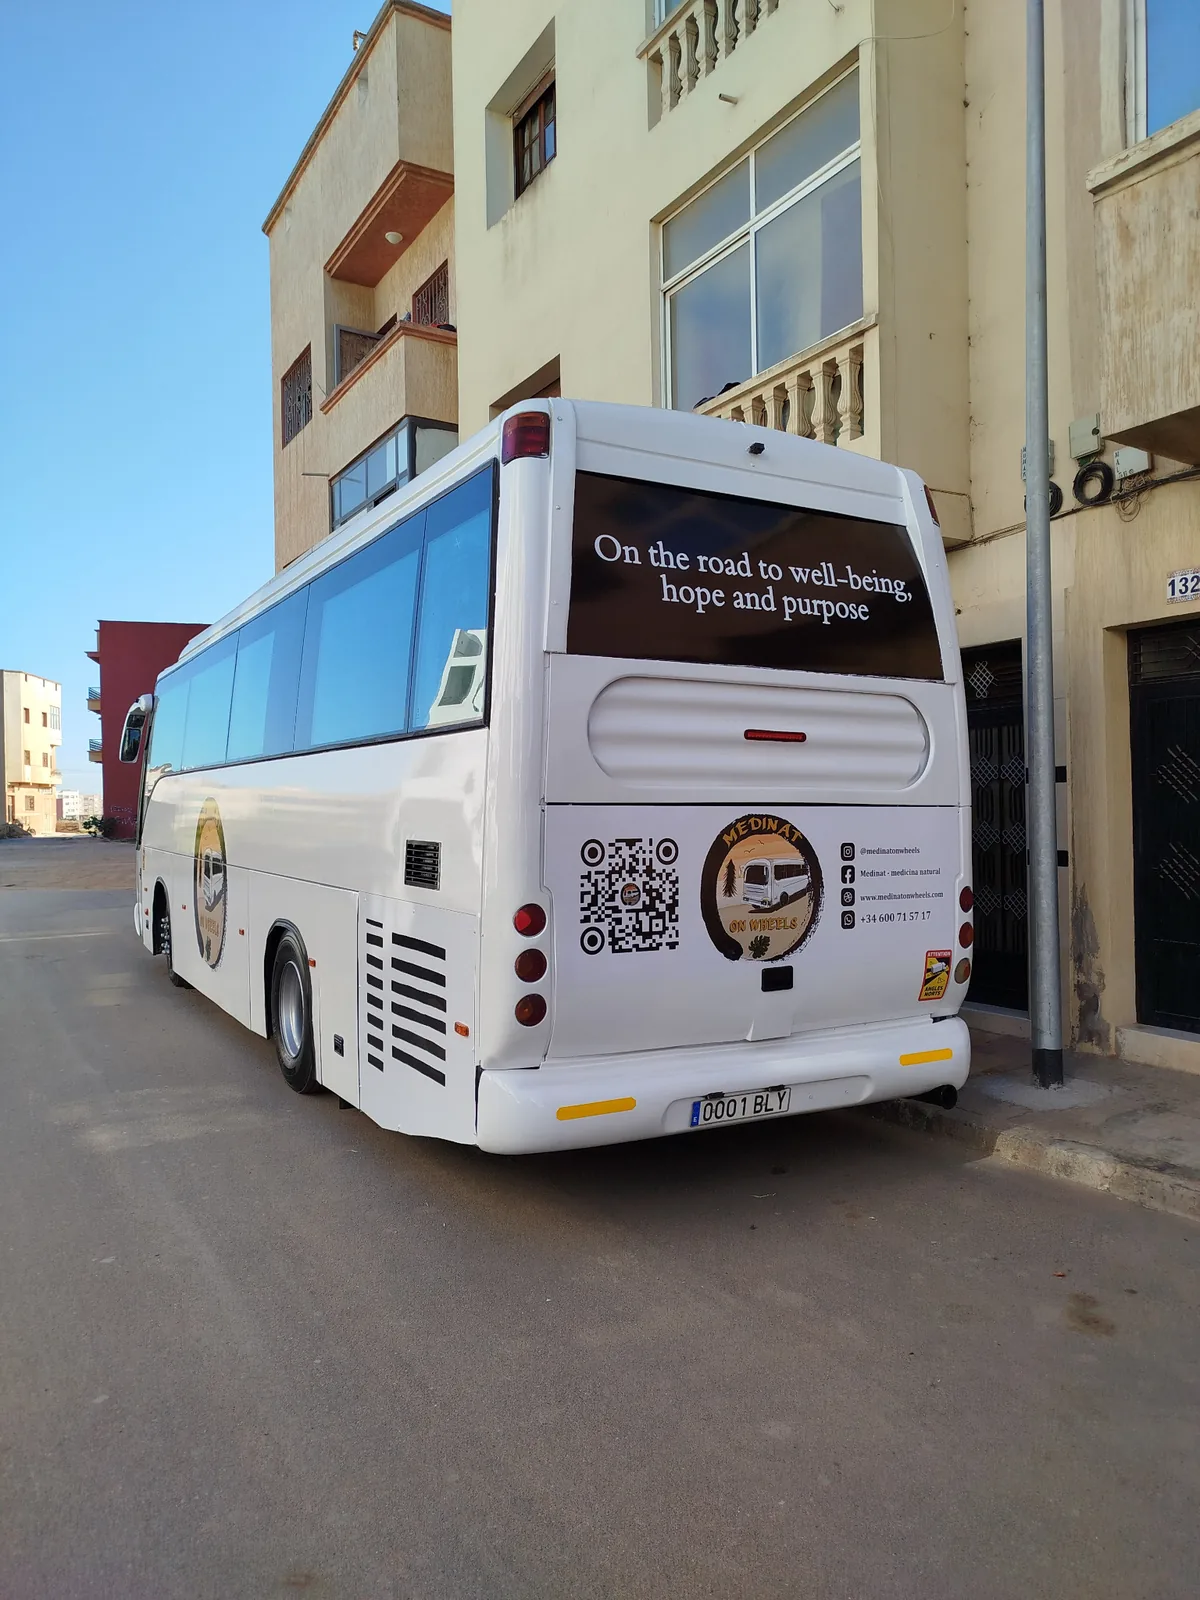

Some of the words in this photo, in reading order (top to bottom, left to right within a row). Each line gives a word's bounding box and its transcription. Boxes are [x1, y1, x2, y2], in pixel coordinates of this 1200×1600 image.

[594, 534, 642, 565] On
[648, 541, 690, 570] the
[697, 552, 753, 577] road
[758, 559, 783, 581] to
[788, 562, 912, 602] well-being,
[1168, 575, 1200, 596] 132
[660, 574, 725, 613] hope
[733, 586, 777, 612] and
[782, 595, 870, 625] purpose
[722, 817, 803, 848] MEDINAT
[860, 846, 920, 855] @medinatonwheels
[860, 869, 886, 878] Medinat
[891, 868, 919, 877] medicina
[919, 867, 941, 875] natural
[860, 891, 944, 901] www.medinatonwheels.com
[729, 919, 747, 933] ON
[749, 916, 798, 932] WHEELS
[860, 913, 877, 924] +34
[879, 913, 895, 923] 600
[897, 912, 907, 922] 71
[909, 911, 919, 921] 57
[921, 911, 931, 920] 17
[703, 1097, 747, 1121] 0001
[753, 1091, 787, 1114] BLY
